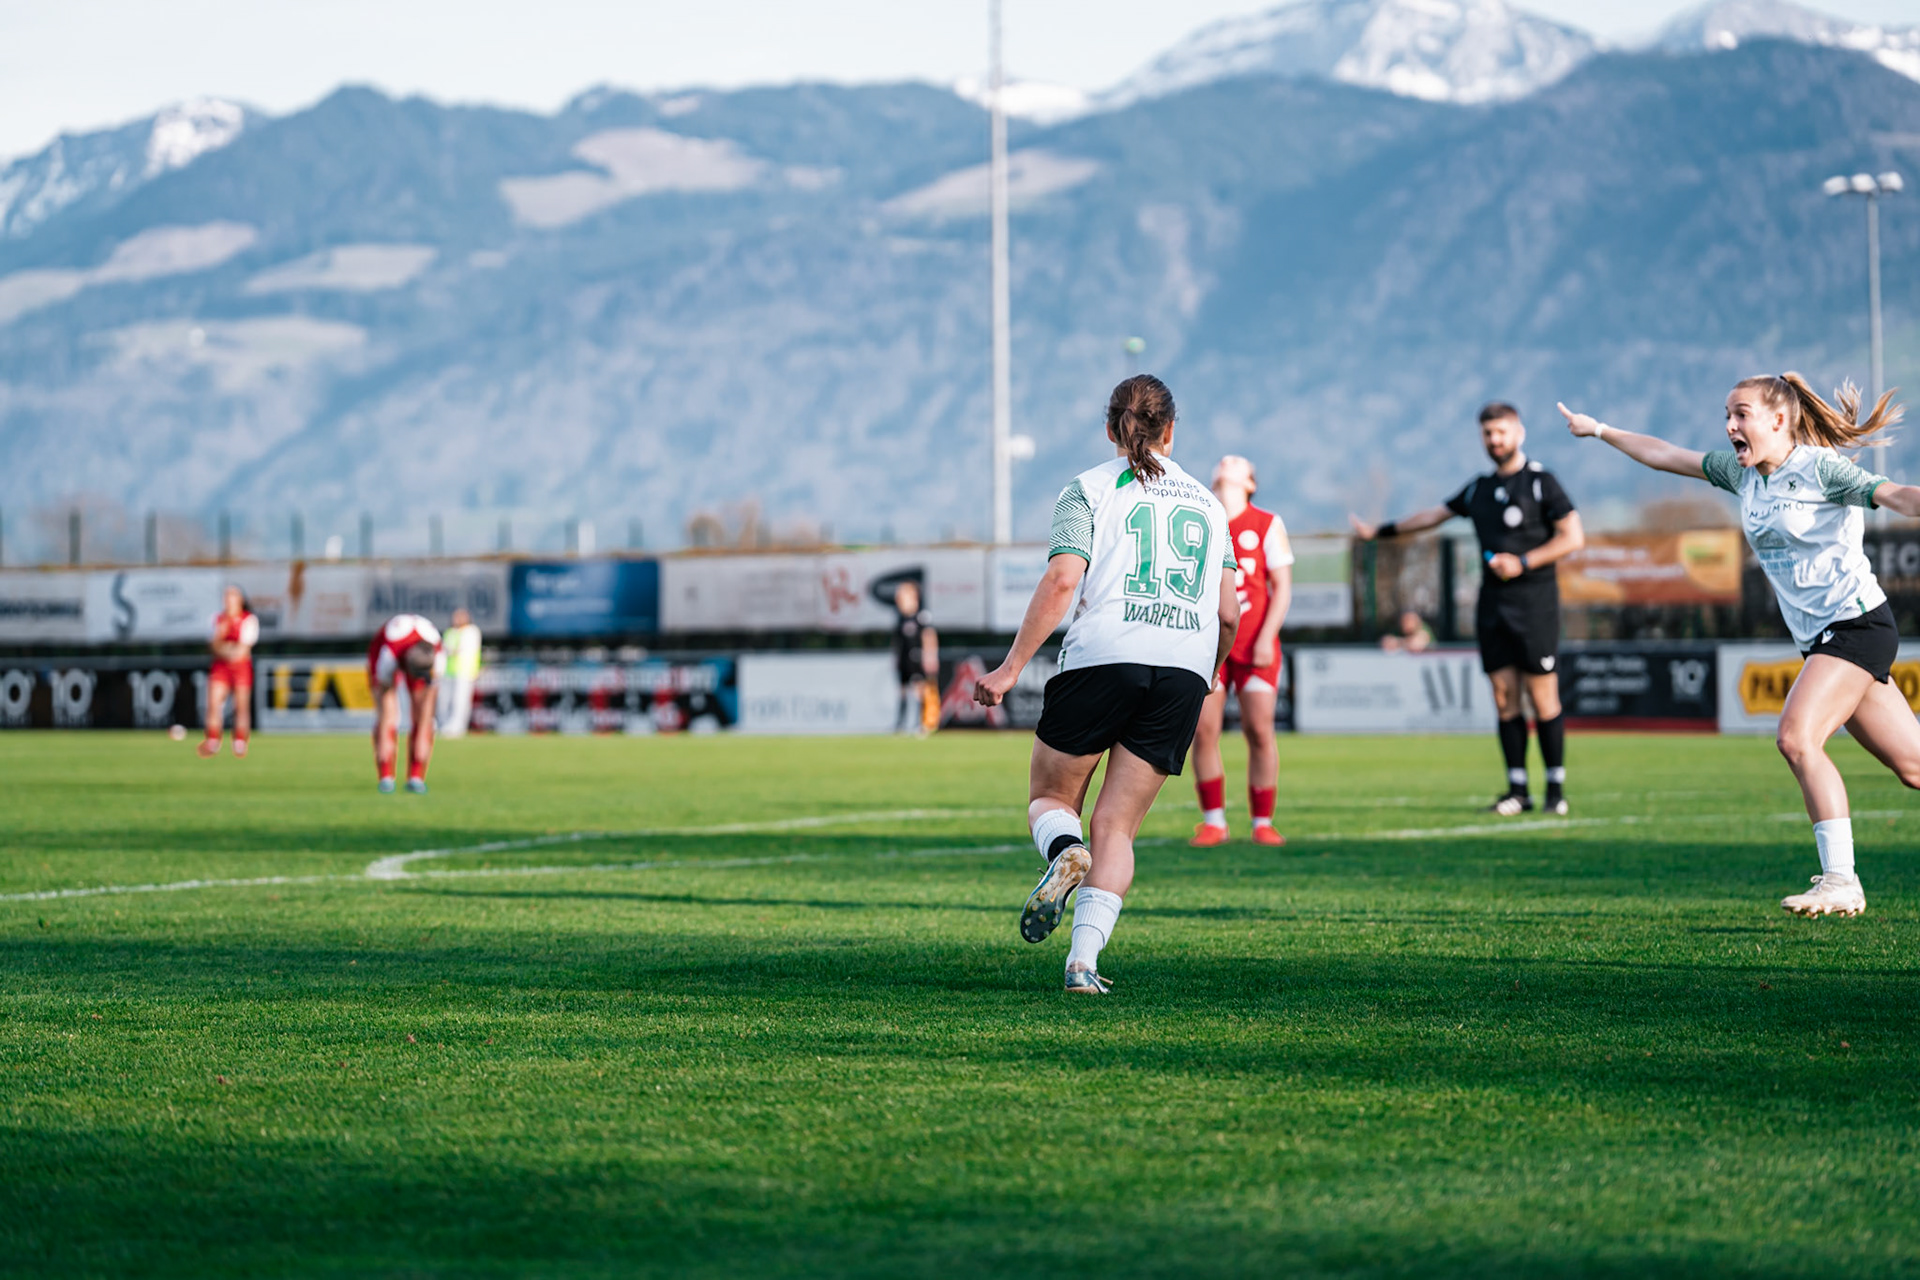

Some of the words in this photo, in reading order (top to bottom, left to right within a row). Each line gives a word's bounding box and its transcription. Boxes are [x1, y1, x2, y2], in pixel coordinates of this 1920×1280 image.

[1144, 485, 1211, 507] Populaires
[1125, 502, 1212, 603] 19
[1123, 602, 1201, 631] WARPELIN
